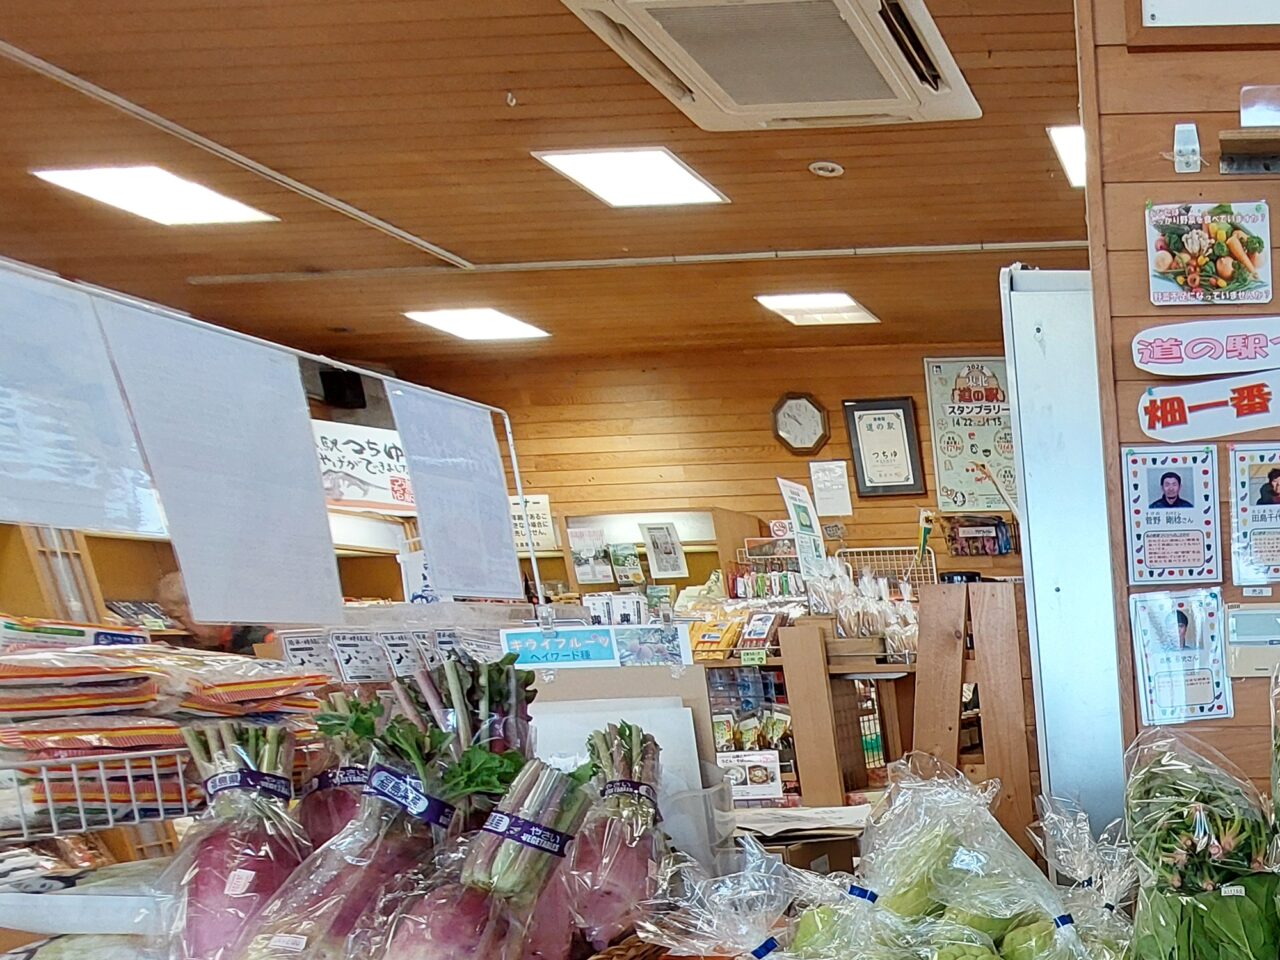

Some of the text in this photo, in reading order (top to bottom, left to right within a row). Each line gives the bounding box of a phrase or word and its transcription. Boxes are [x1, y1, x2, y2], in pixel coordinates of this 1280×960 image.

[958, 387, 1000, 402] 道の駅
[947, 404, 1010, 416] スタンプラリー
[866, 422, 896, 432] 道の駅
[872, 450, 898, 460] つちゆ
[530, 825, 561, 844] やさい
